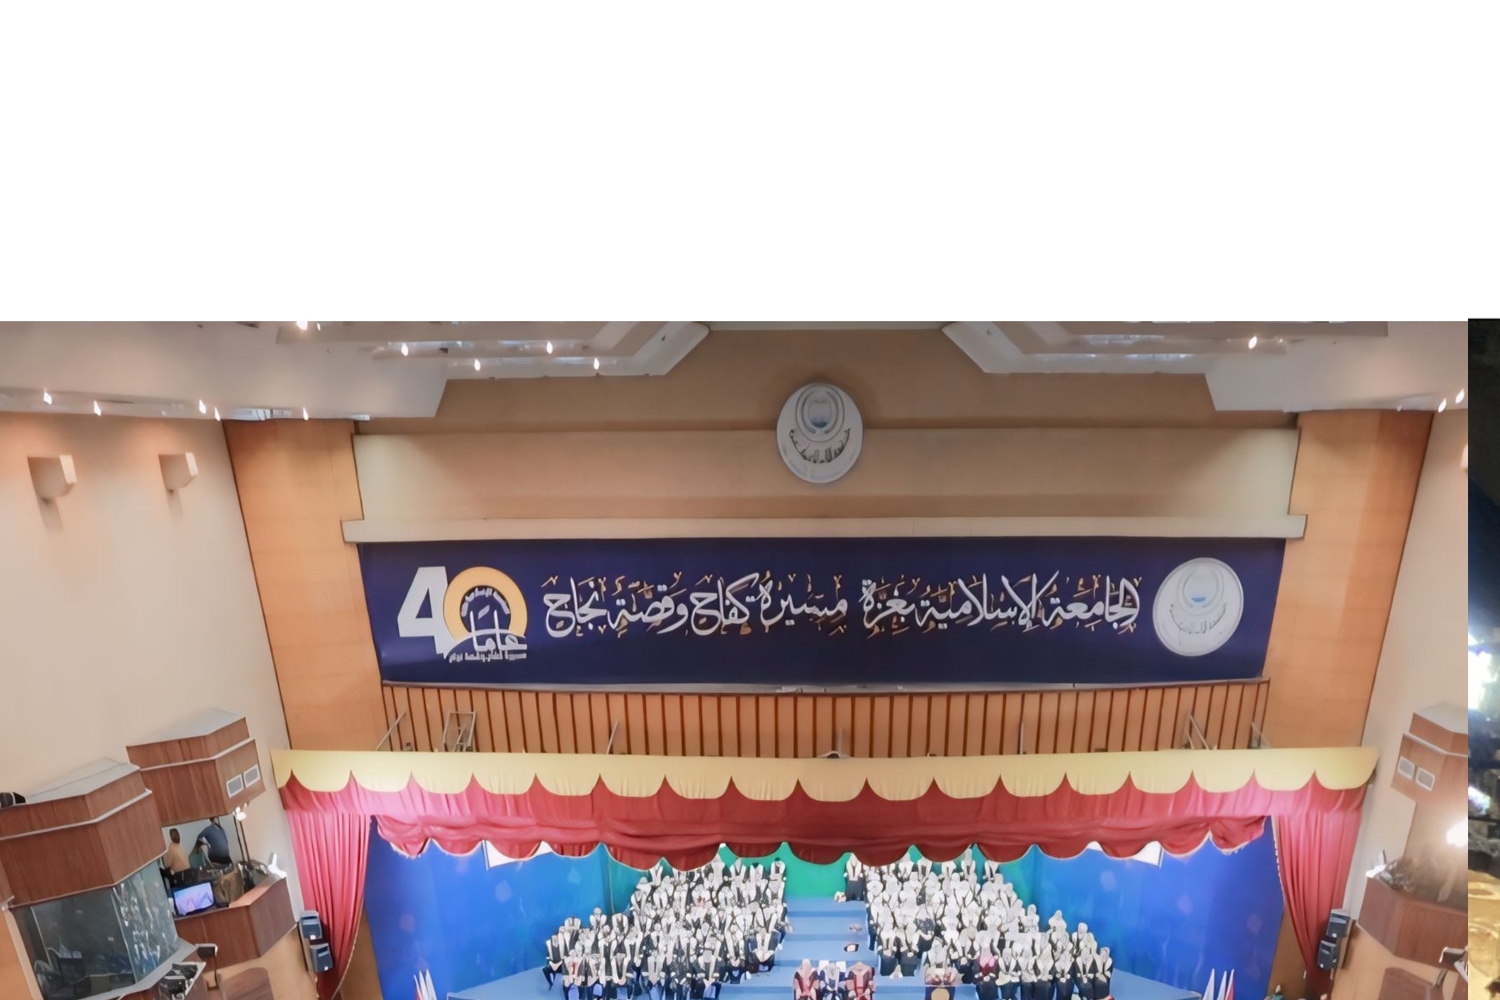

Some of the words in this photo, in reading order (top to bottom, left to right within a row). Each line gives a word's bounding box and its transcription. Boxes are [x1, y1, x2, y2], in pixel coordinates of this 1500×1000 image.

[397, 566, 528, 654] 40
[541, 575, 607, 637] نجاح
[606, 571, 689, 638] وقصة
[689, 572, 760, 636] كفاح
[746, 570, 848, 636] مسيرة
[859, 574, 920, 638] بغزة
[914, 570, 1060, 633] الإسلامية
[1043, 575, 1143, 634] الجامعة
